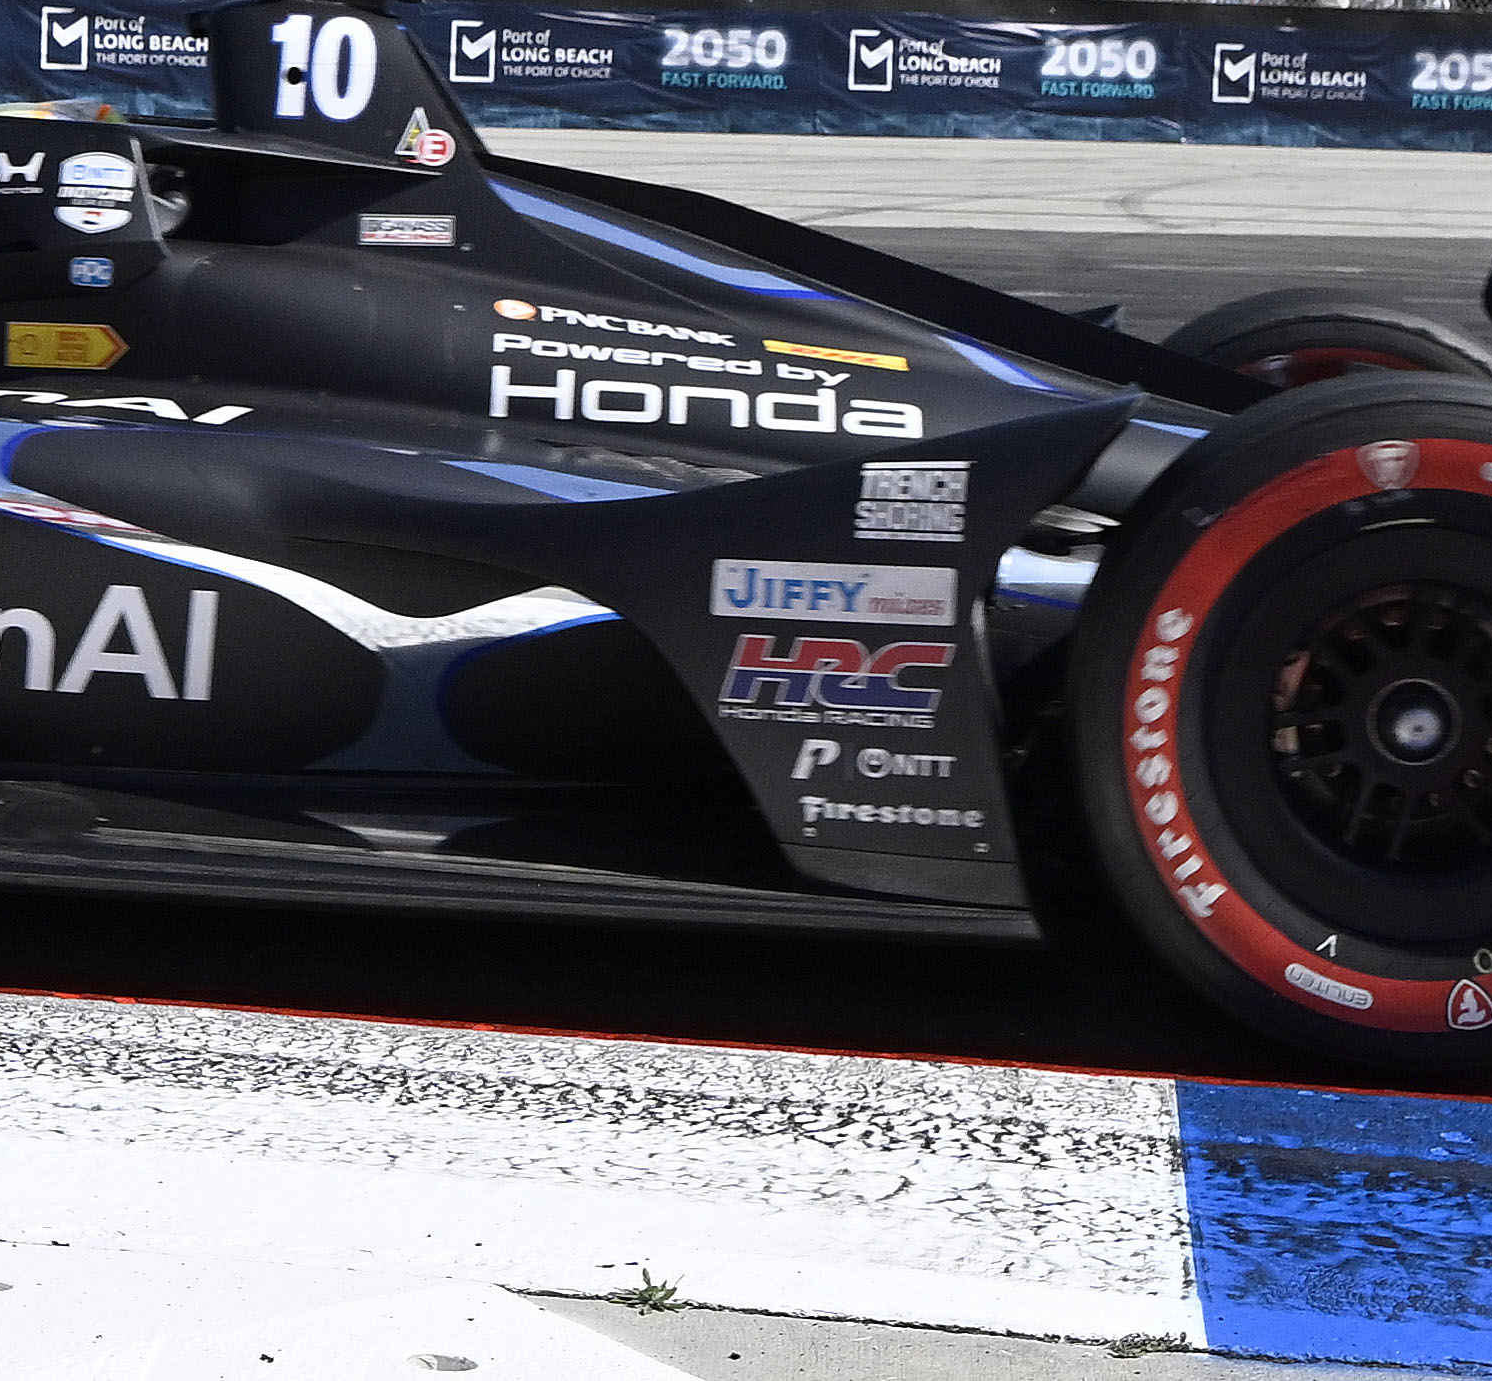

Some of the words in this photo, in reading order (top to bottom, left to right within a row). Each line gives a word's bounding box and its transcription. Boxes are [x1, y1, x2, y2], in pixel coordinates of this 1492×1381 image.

[129, 16, 145, 33] of
[503, 29, 533, 43] Port
[536, 30, 550, 45] of
[94, 34, 144, 50] LONG
[150, 35, 209, 52] BEACH
[662, 29, 785, 67] 2050
[271, 14, 378, 121] 10
[502, 48, 549, 63] LONG
[556, 48, 613, 65] BEACH
[899, 57, 944, 72] LONG
[1041, 40, 1155, 77] 2050
[1291, 53, 1306, 68] of
[1260, 69, 1305, 84] LONG
[1311, 72, 1366, 87] BEACH
[493, 333, 761, 375] Powered
[776, 363, 850, 387] by
[488, 365, 923, 439] Honda
[719, 634, 956, 713] HRC
[823, 710, 935, 729] RACING
[1129, 607, 1227, 918] Firestone
[798, 796, 986, 828] Firestone
